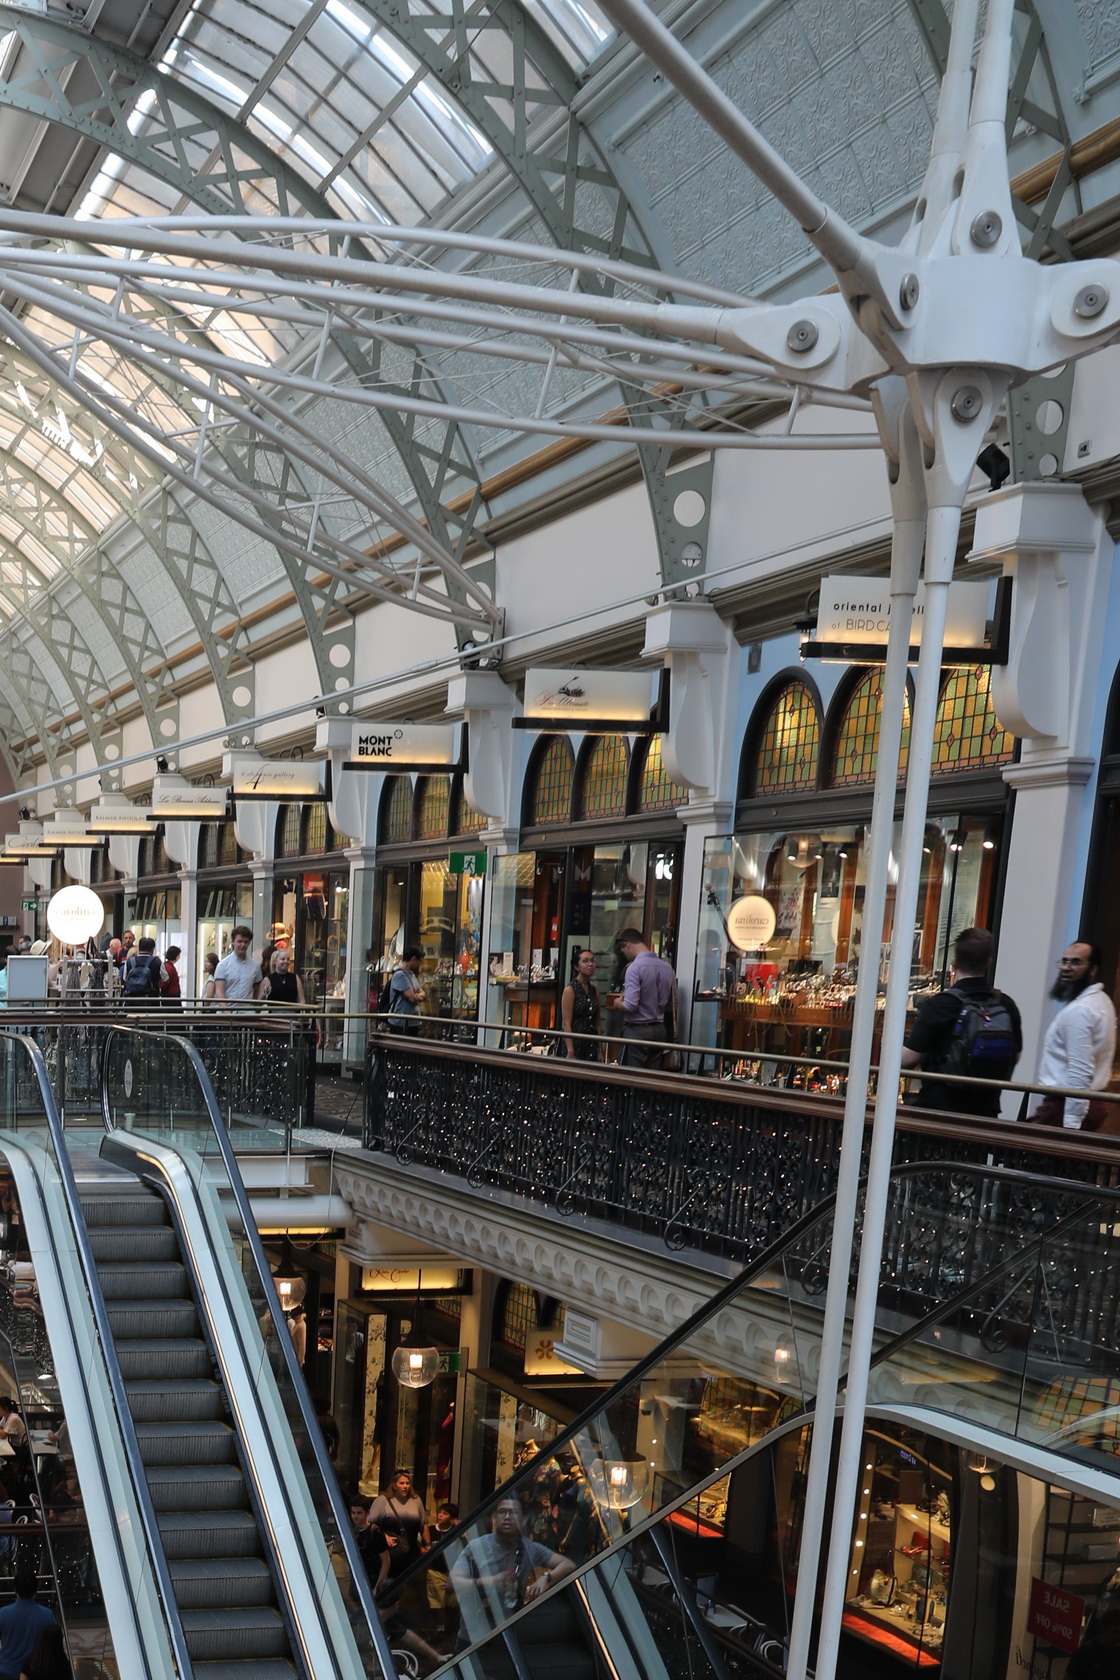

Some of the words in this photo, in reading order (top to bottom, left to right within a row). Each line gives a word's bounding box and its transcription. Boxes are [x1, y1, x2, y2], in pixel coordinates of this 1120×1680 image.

[833, 601, 881, 613] oriental
[832, 622, 841, 630] of
[359, 735, 393, 746] MONT
[358, 746, 392, 757] BLANC
